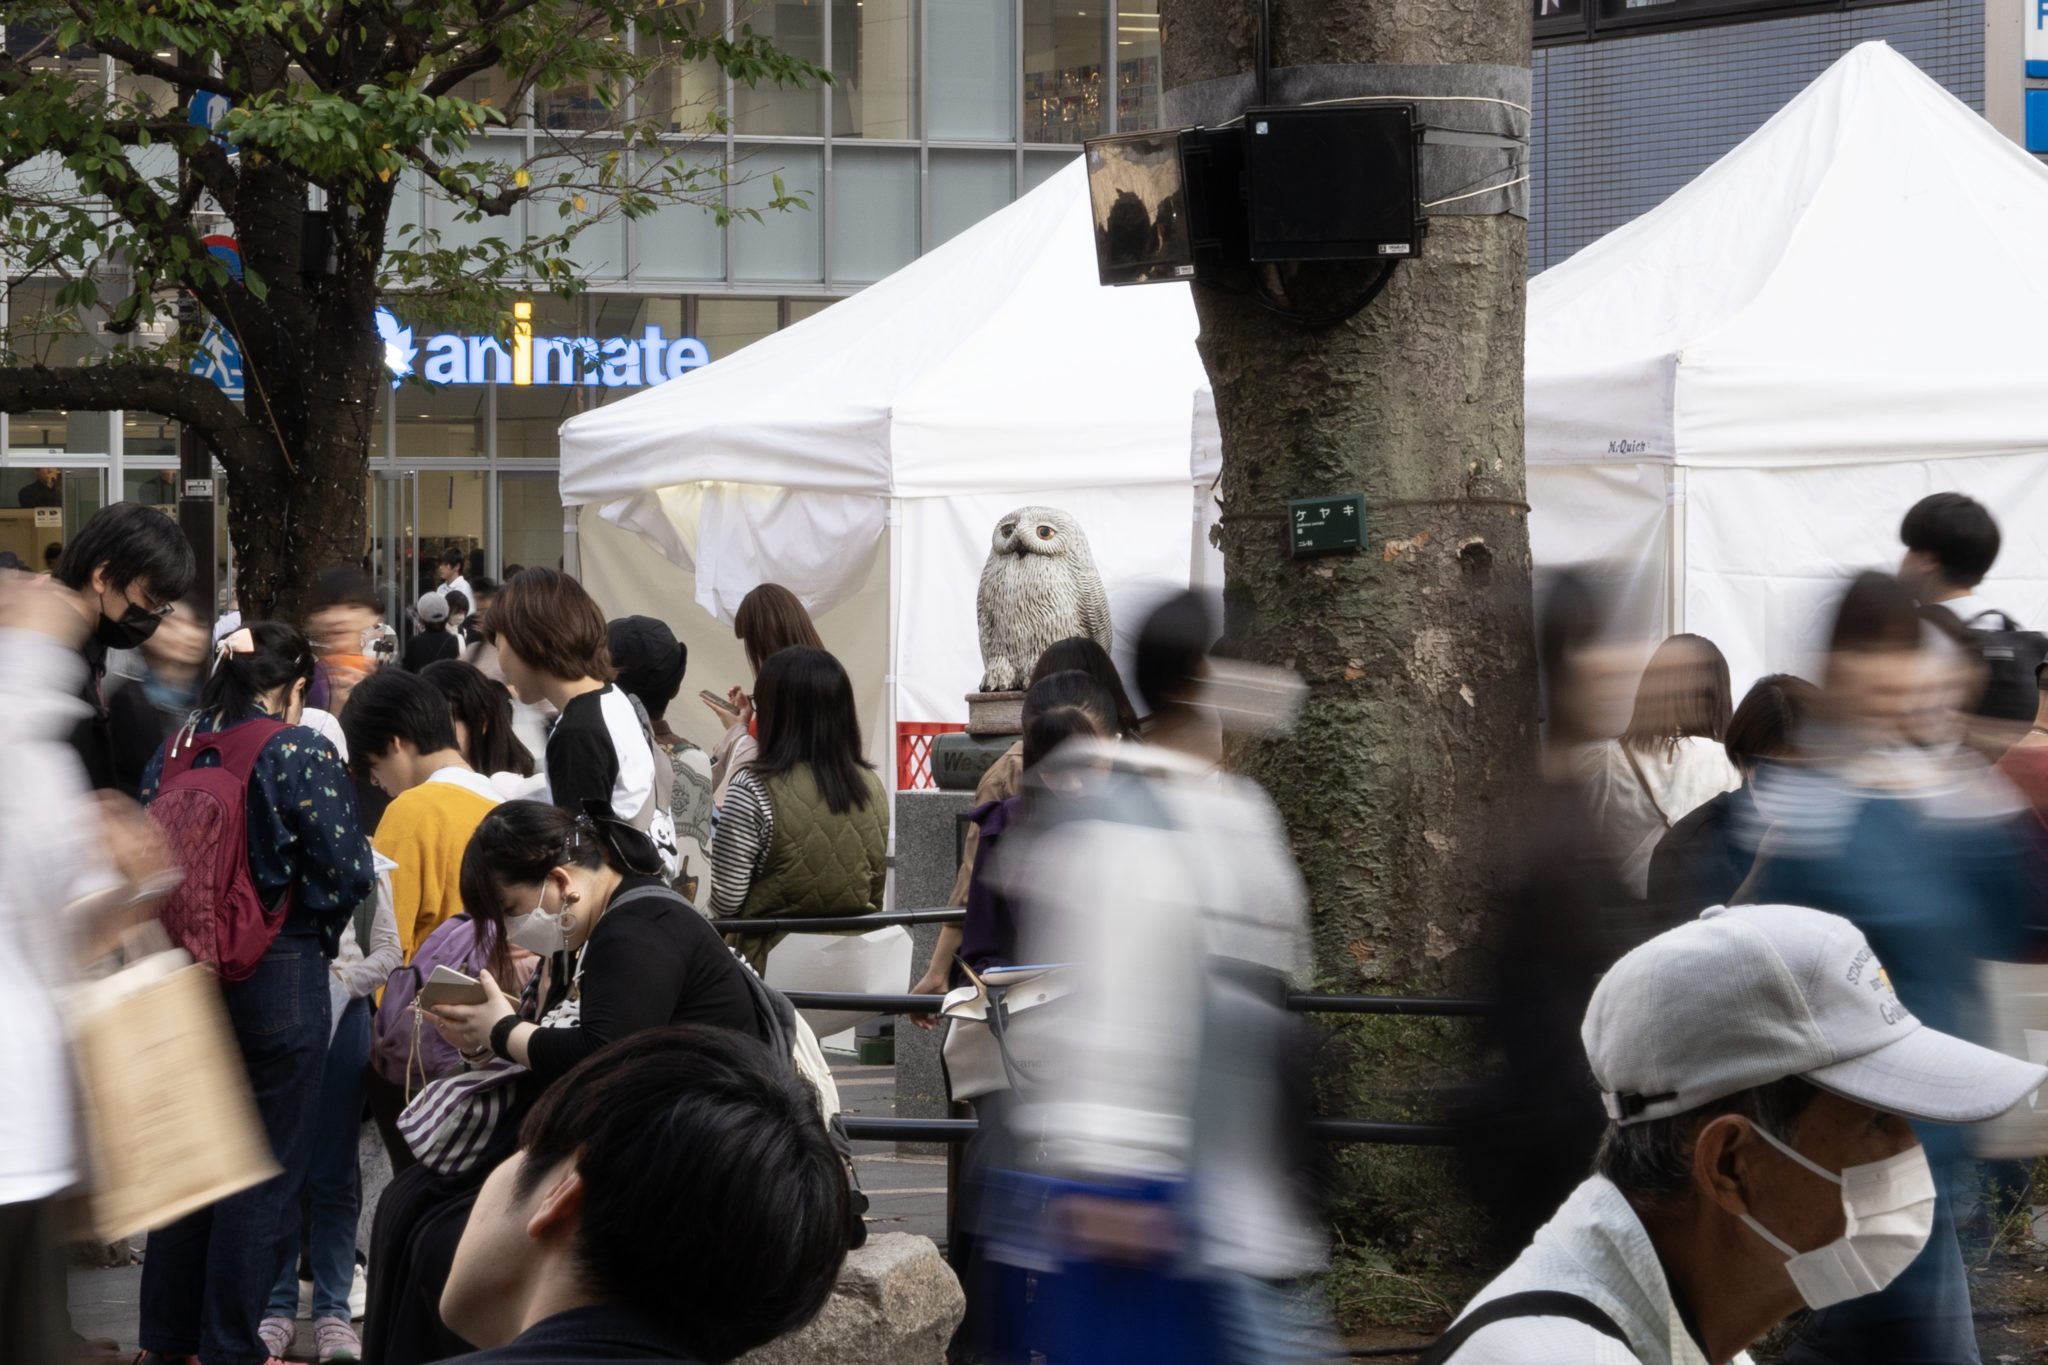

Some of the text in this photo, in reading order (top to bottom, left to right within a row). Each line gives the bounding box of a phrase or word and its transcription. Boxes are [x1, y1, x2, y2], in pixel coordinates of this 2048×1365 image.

[424, 302, 710, 387] animate
[1296, 504, 1354, 521] ケヤキ
[943, 751, 972, 772] We
